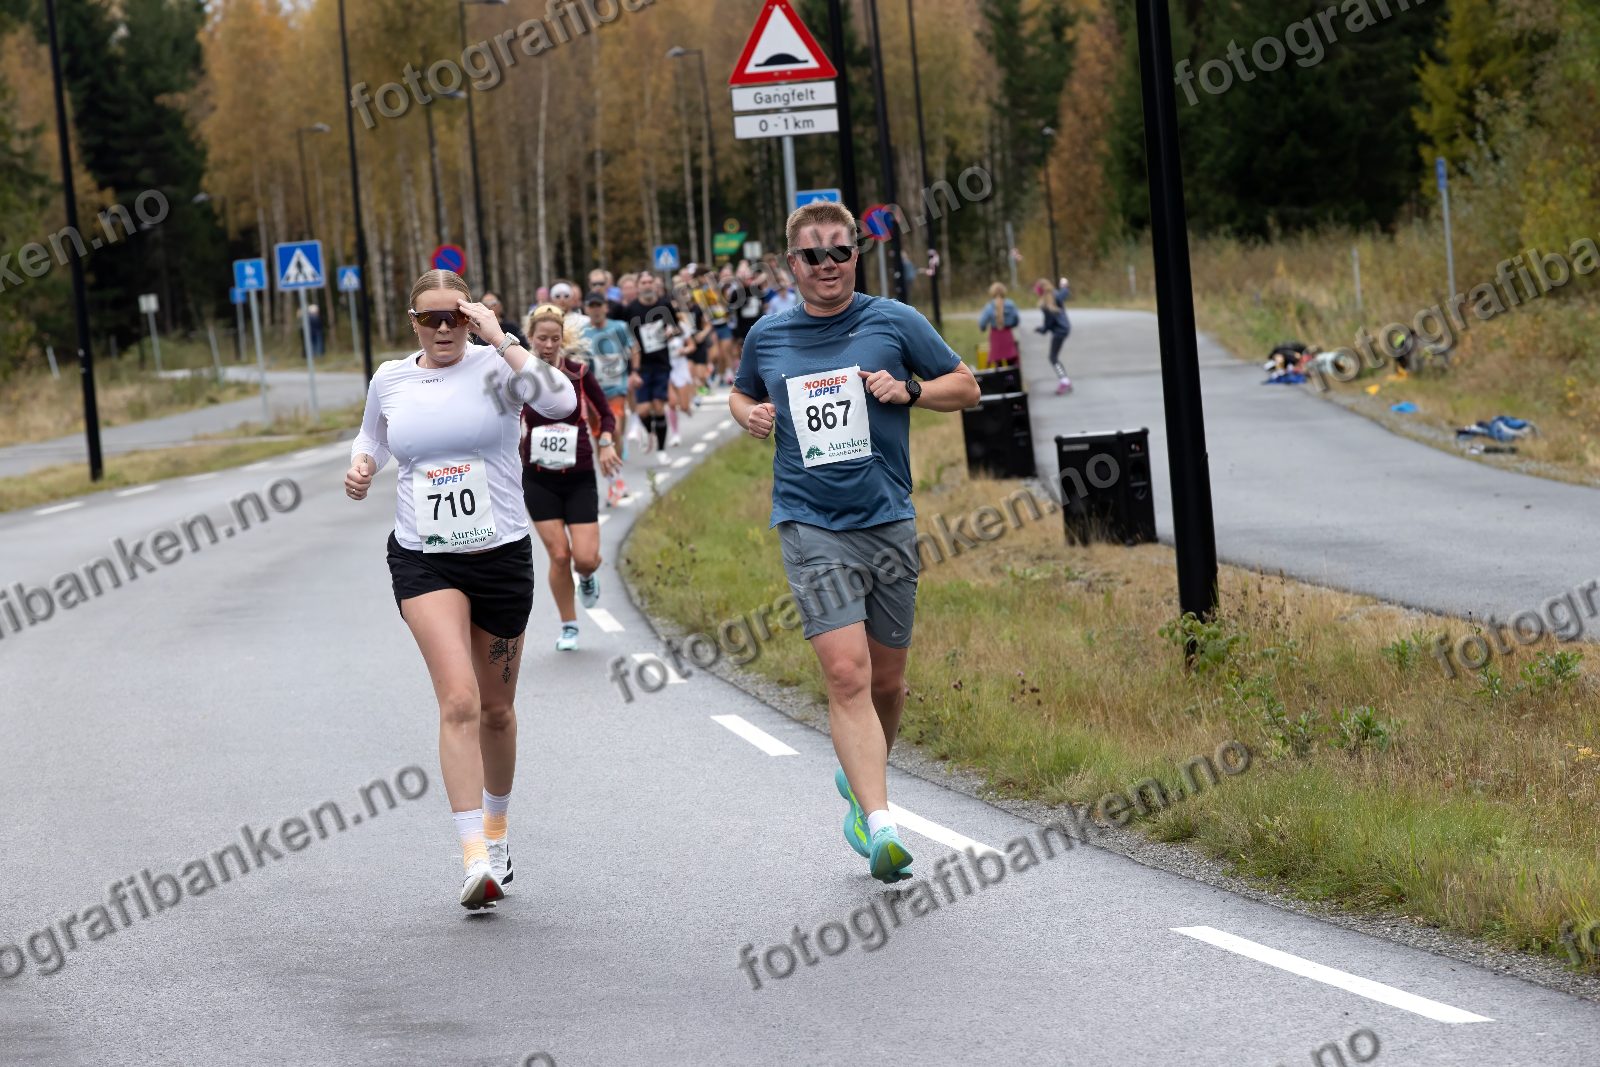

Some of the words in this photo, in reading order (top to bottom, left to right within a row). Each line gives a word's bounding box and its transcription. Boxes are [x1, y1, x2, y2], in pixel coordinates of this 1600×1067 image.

[753, 87, 816, 106] Gangfelt
[758, 119, 769, 132] 0
[783, 117, 789, 130] 1
[793, 115, 815, 129] km
[802, 375, 848, 391] NORGES
[809, 384, 842, 398] LØPET
[806, 399, 851, 433] 867
[540, 436, 567, 452] 482
[828, 438, 869, 452] Aurskog
[426, 463, 471, 479] NORGES
[432, 473, 465, 486] LØPET
[427, 488, 476, 520] 710
[450, 526, 494, 541] Aurskog
